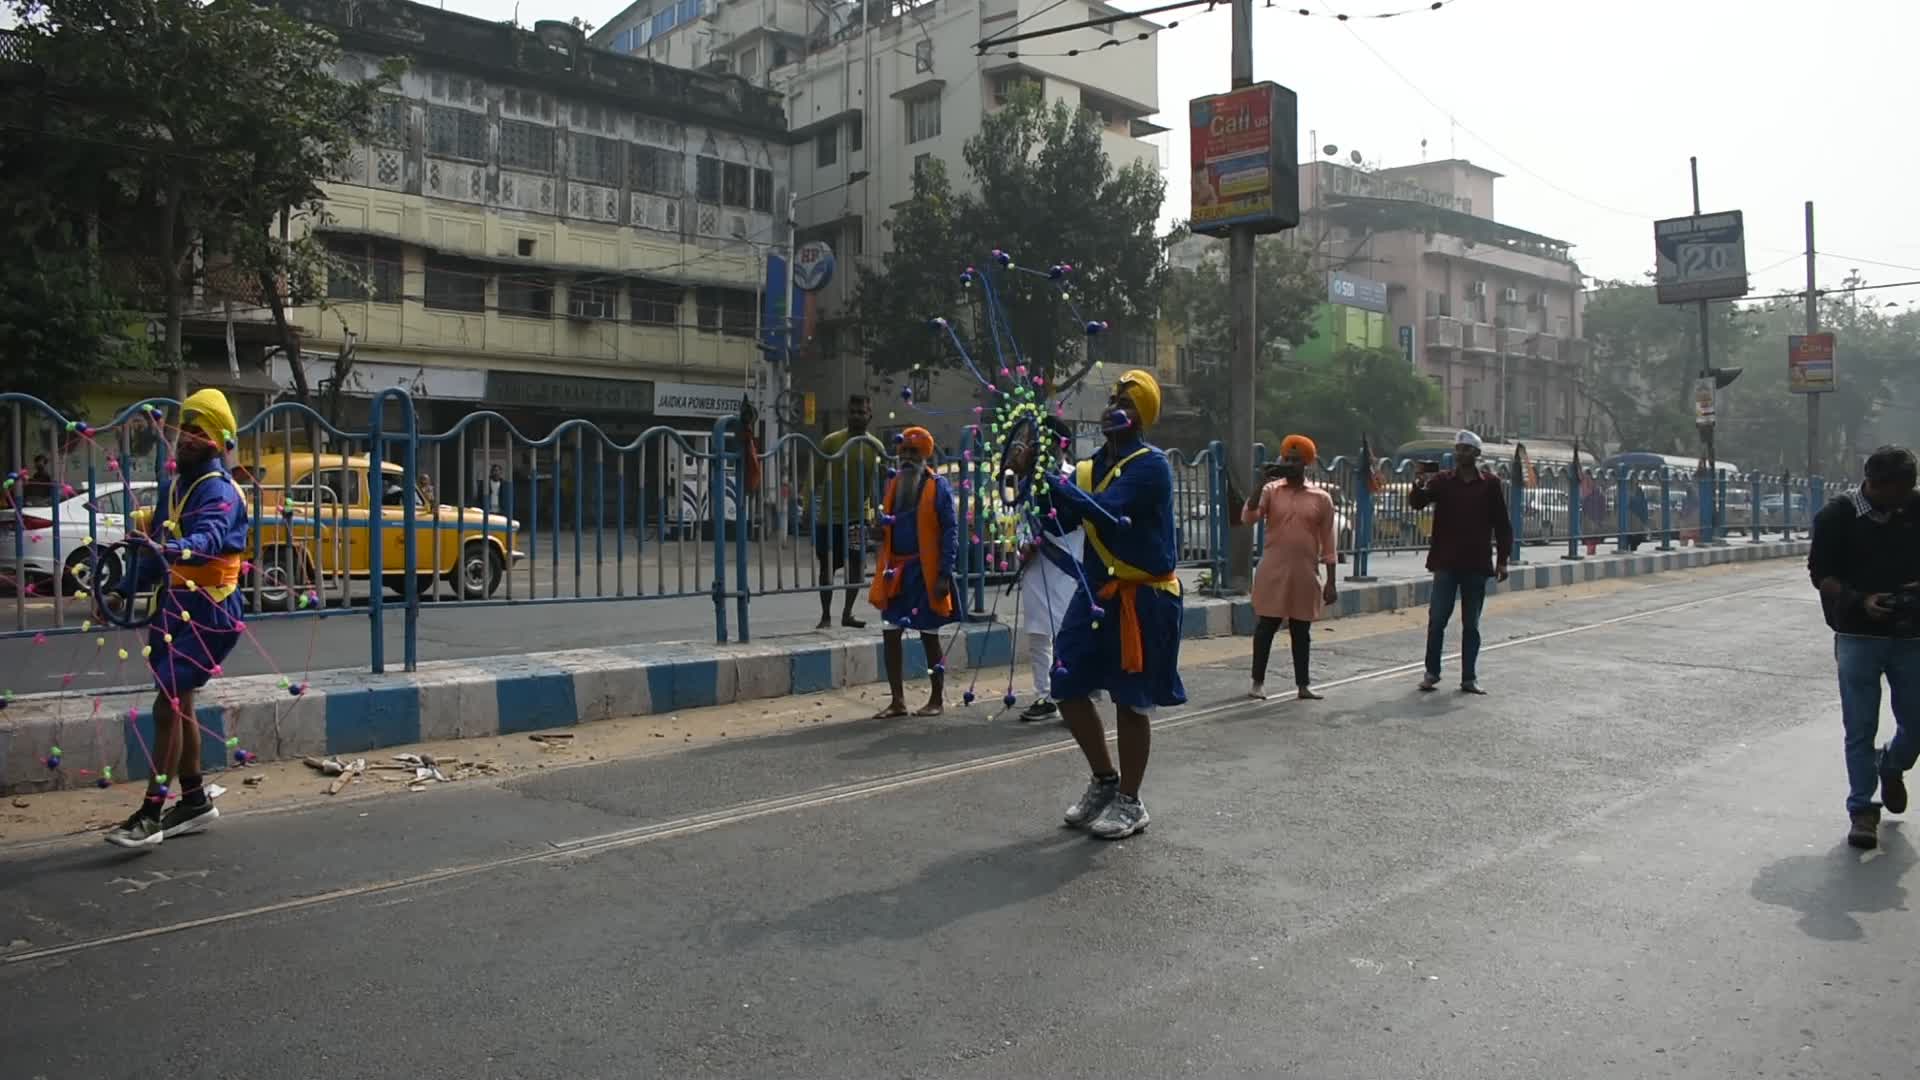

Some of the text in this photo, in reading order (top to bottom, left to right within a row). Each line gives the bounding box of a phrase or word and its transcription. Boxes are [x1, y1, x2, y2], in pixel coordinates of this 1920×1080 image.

[1210, 104, 1249, 137] Call
[800, 248, 819, 264] HP
[688, 396, 715, 410] POWER
